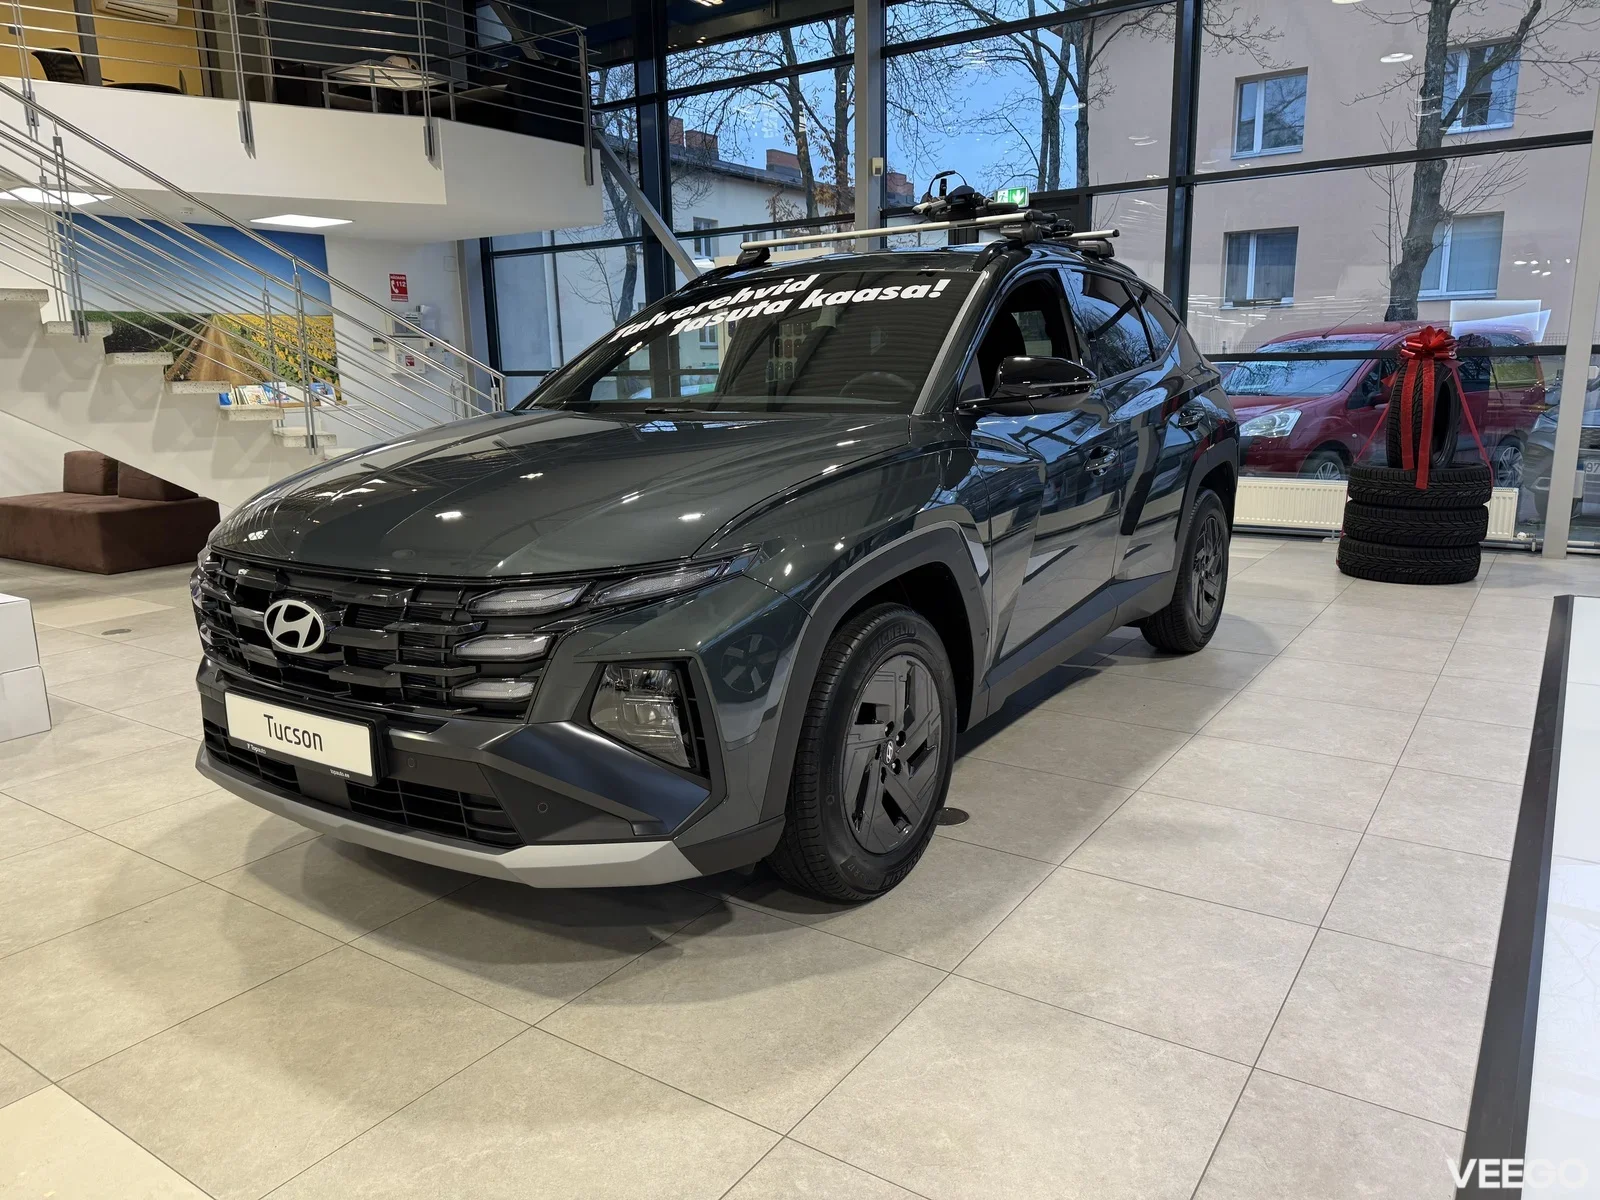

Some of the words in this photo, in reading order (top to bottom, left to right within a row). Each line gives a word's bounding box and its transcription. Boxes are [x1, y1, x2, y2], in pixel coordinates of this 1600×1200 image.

[608, 274, 820, 343] Talverehvid
[669, 299, 793, 336] tasuta
[799, 279, 951, 310] kaasa!
[263, 714, 323, 752] Tucson
